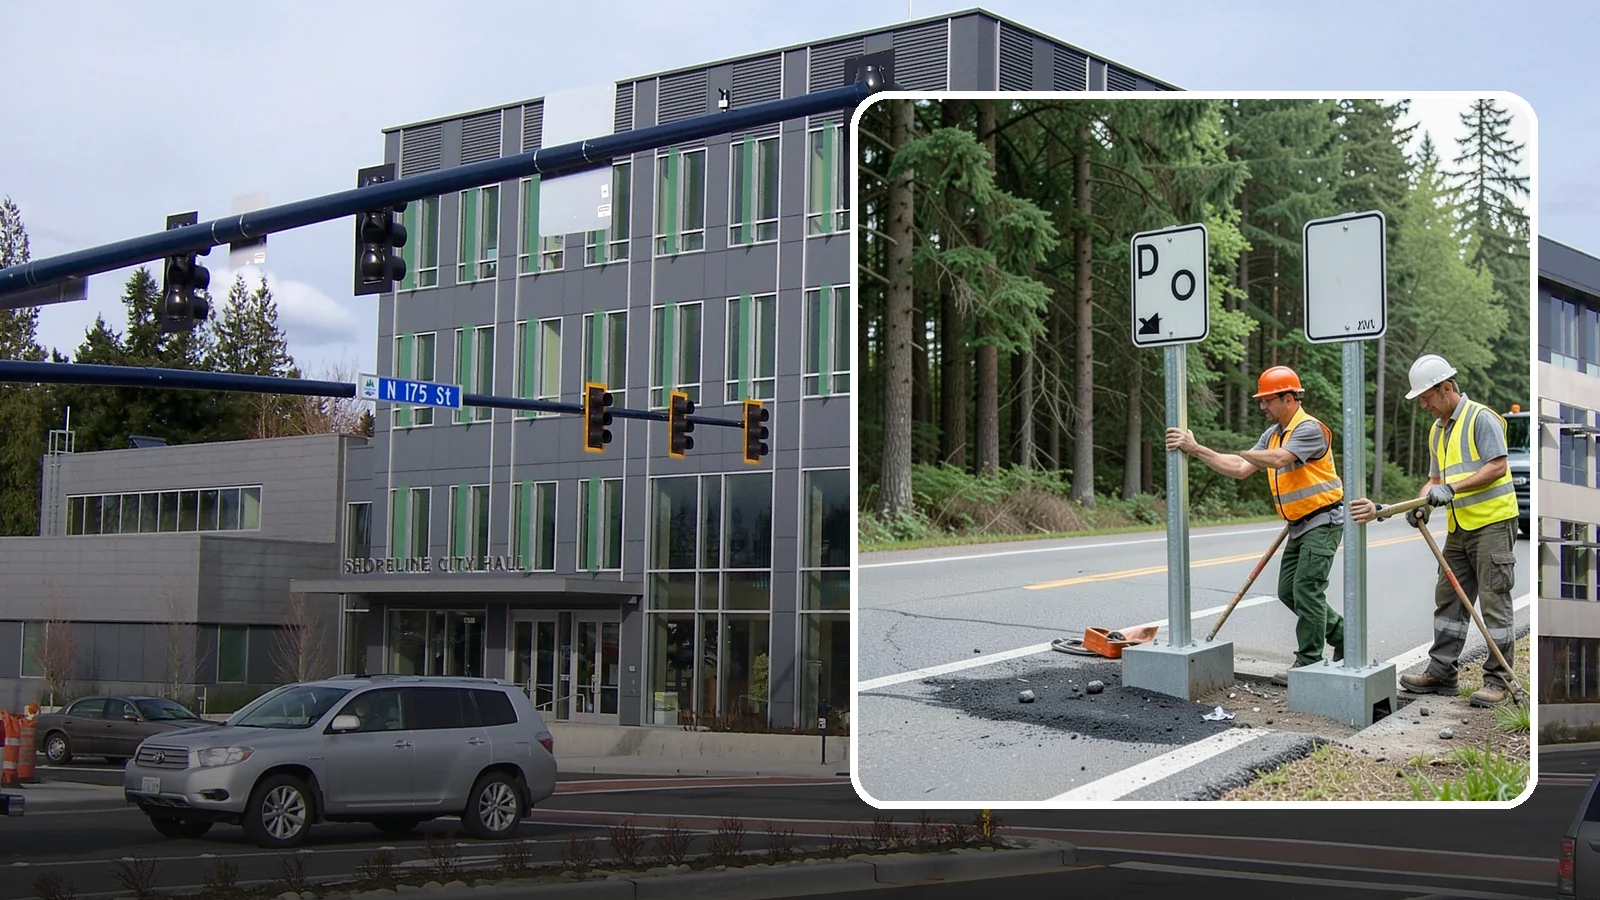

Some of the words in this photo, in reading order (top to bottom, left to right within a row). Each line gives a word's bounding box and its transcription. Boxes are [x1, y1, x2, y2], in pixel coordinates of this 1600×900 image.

[387, 380, 396, 400] N
[405, 382, 427, 403] 175
[436, 386, 451, 406] St
[345, 556, 431, 574] SHORELINE
[438, 556, 475, 572] CITY
[483, 555, 526, 571] HALL
